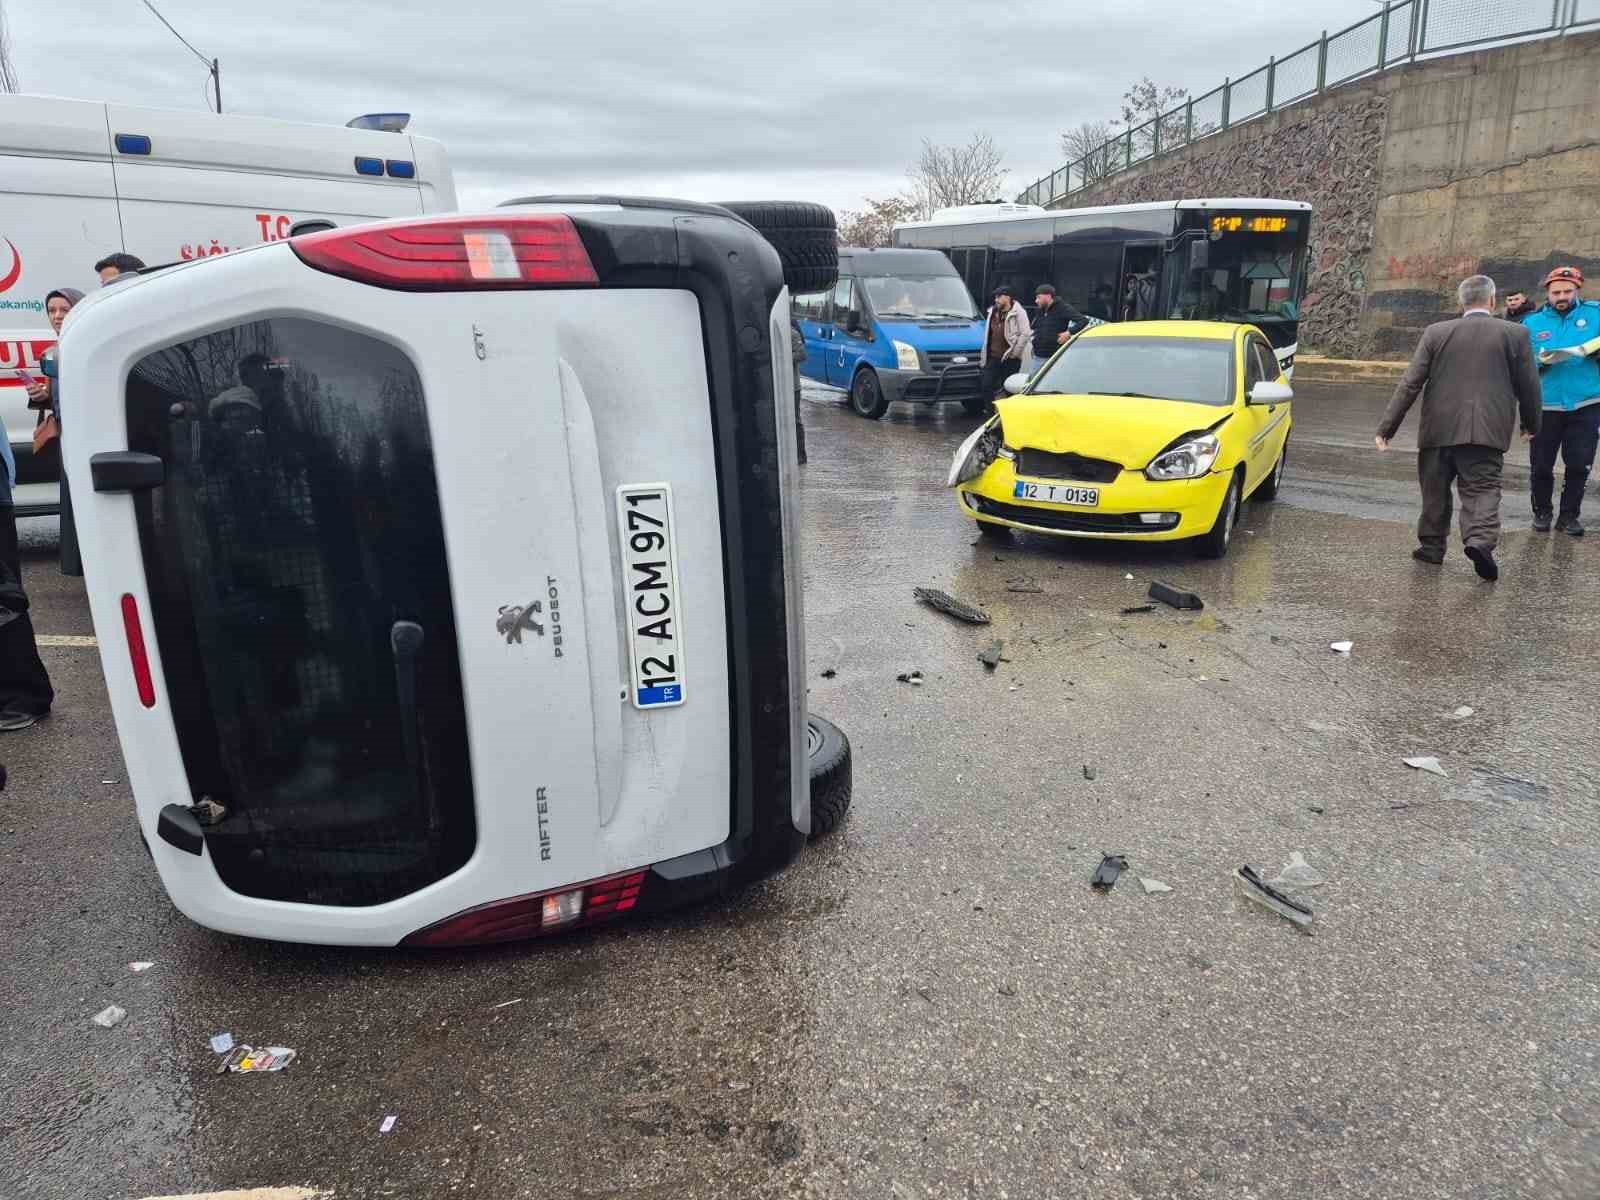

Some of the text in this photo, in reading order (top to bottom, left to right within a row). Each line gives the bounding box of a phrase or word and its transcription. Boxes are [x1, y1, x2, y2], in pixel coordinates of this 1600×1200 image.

[472, 323, 486, 361] GT
[1024, 484, 1097, 503] 12 T 0139
[547, 576, 563, 658] PEUGEOT
[626, 494, 676, 689] 12 ACM 971
[664, 687, 674, 702] TR
[536, 786, 551, 861] RIFTER
